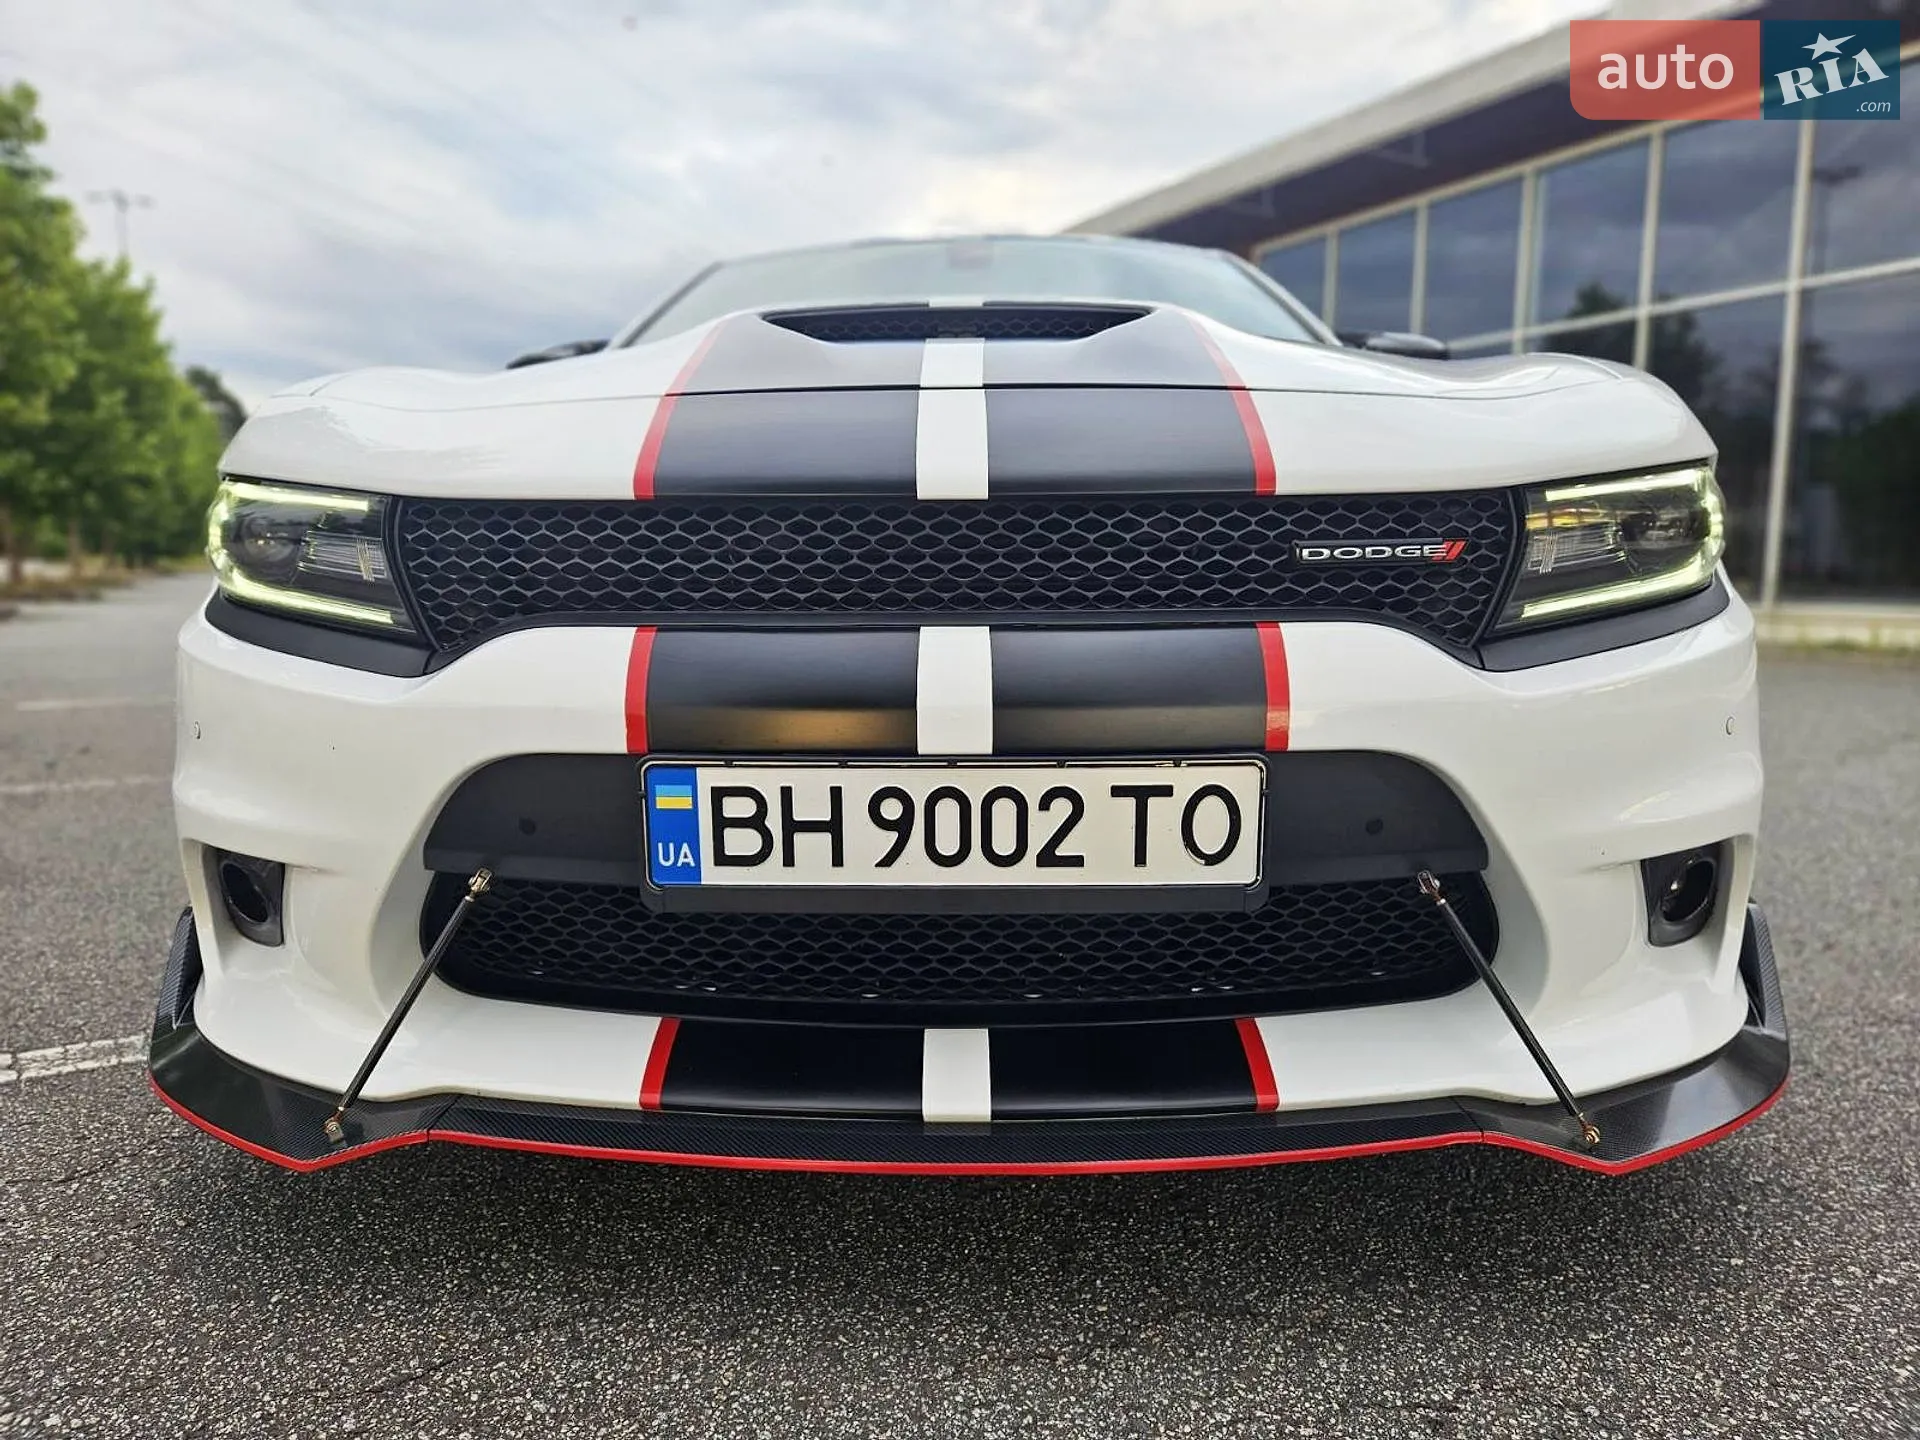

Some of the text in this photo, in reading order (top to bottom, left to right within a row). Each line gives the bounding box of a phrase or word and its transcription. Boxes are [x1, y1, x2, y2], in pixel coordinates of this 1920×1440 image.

[1301, 545, 1448, 560] DODGE
[709, 784, 1243, 868] BH 9002 TO
[657, 841, 696, 868] UA
